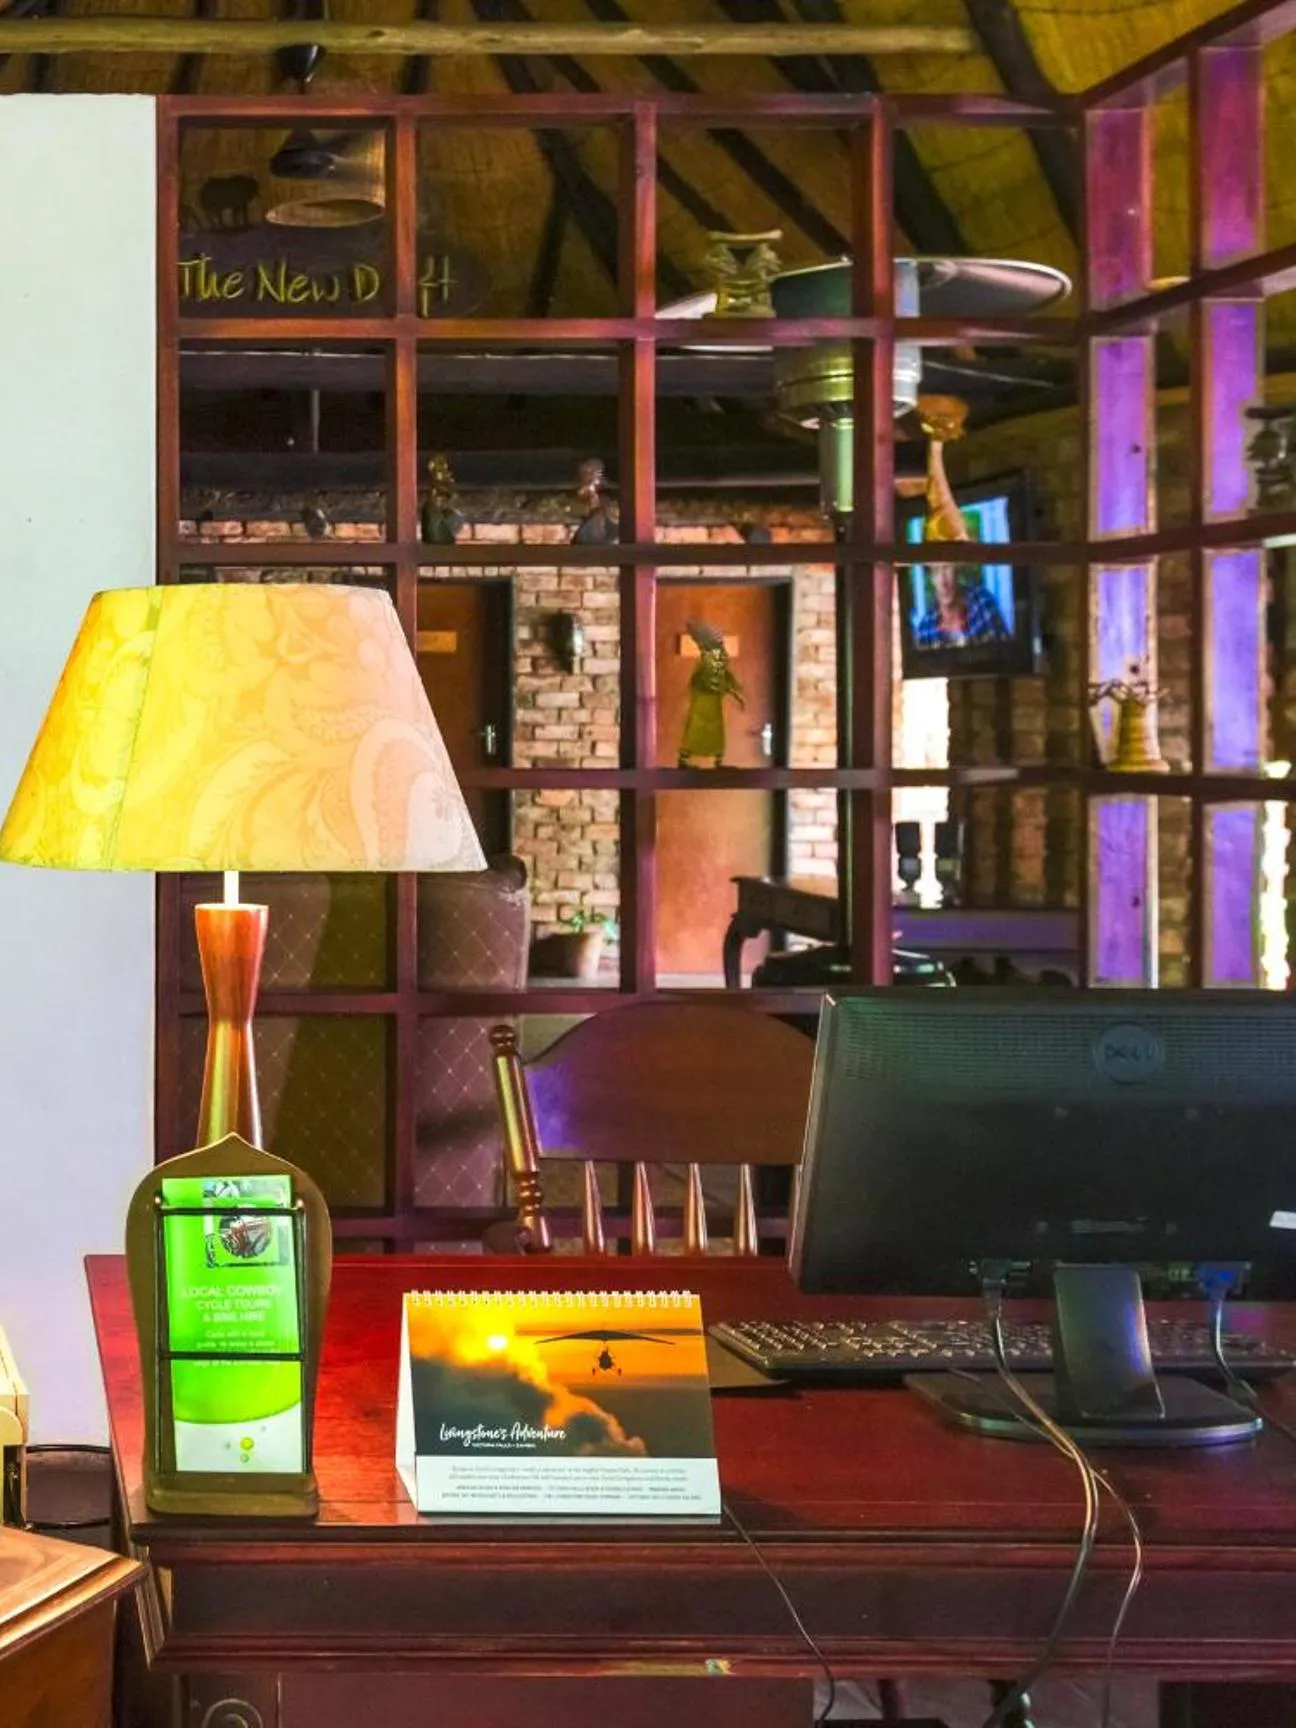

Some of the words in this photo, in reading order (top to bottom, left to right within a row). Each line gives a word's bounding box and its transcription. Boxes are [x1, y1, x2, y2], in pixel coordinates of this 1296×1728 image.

[176, 253, 245, 299] The
[257, 259, 340, 303] New
[510, 1421, 566, 1441] Adventure
